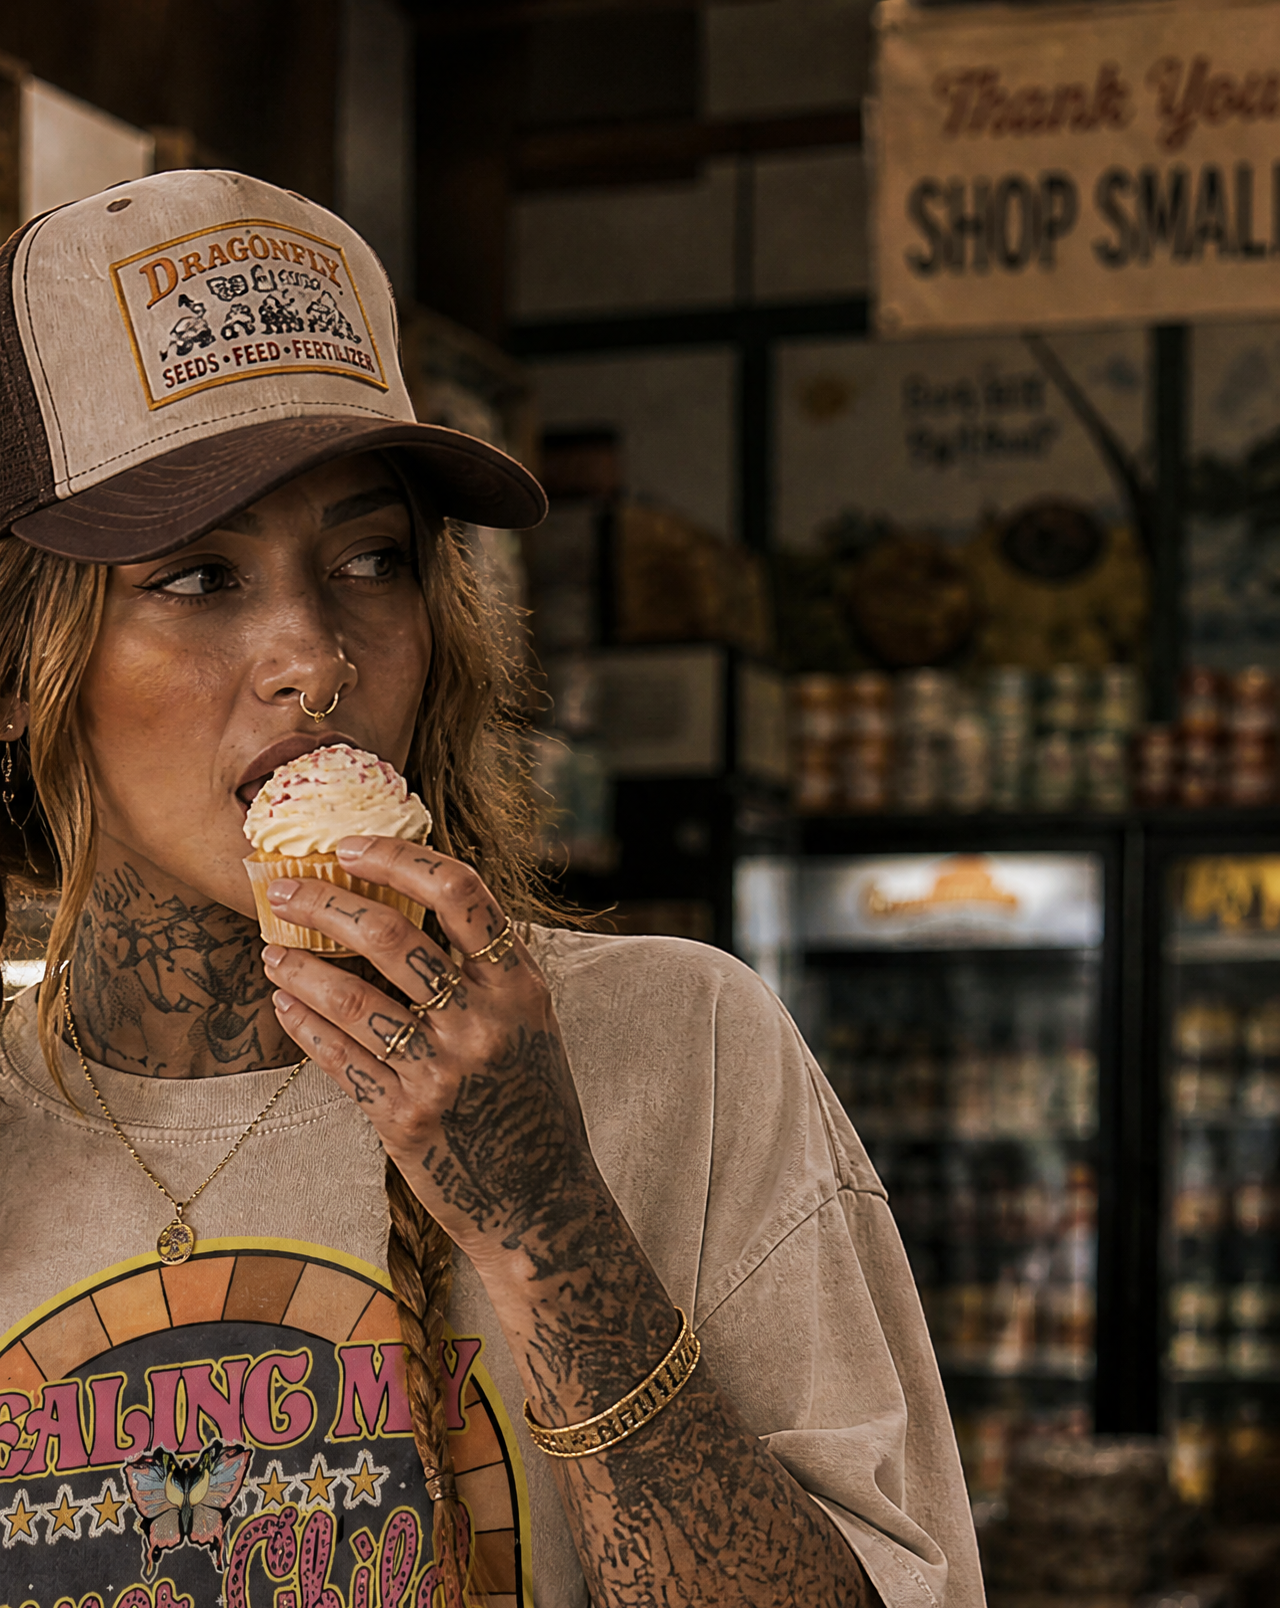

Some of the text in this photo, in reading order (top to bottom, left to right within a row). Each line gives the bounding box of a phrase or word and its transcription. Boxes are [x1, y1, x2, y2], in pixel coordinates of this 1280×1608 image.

[931, 53, 1280, 155] Thank You
[139, 233, 342, 310] DRAGONFLY
[904, 168, 1080, 280] SHOP
[162, 339, 376, 388] SEEDS FEED FERTILIZER
[332, 1337, 486, 1440] MY
